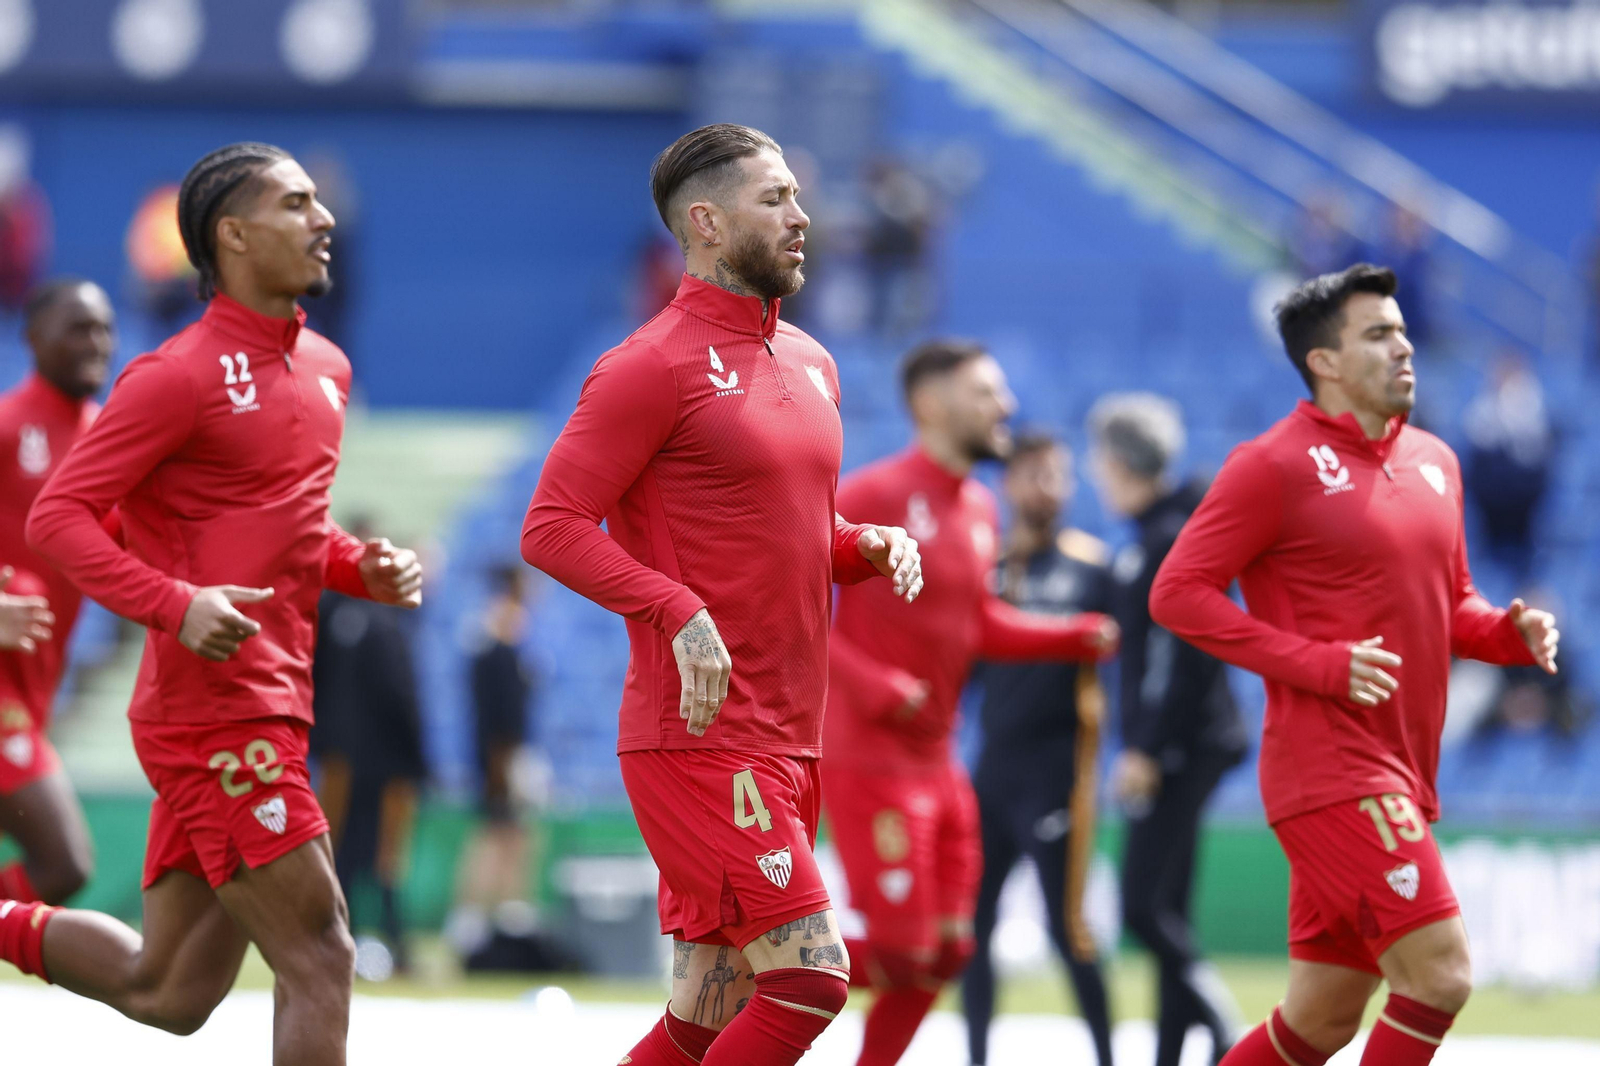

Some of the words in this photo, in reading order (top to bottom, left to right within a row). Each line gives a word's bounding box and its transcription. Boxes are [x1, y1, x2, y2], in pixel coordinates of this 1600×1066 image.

[716, 257, 738, 277] FREE
[219, 351, 253, 385] 22
[708, 345, 725, 373] 4
[1307, 444, 1340, 471] 19
[733, 769, 773, 833] 4
[1358, 793, 1425, 852] 19
